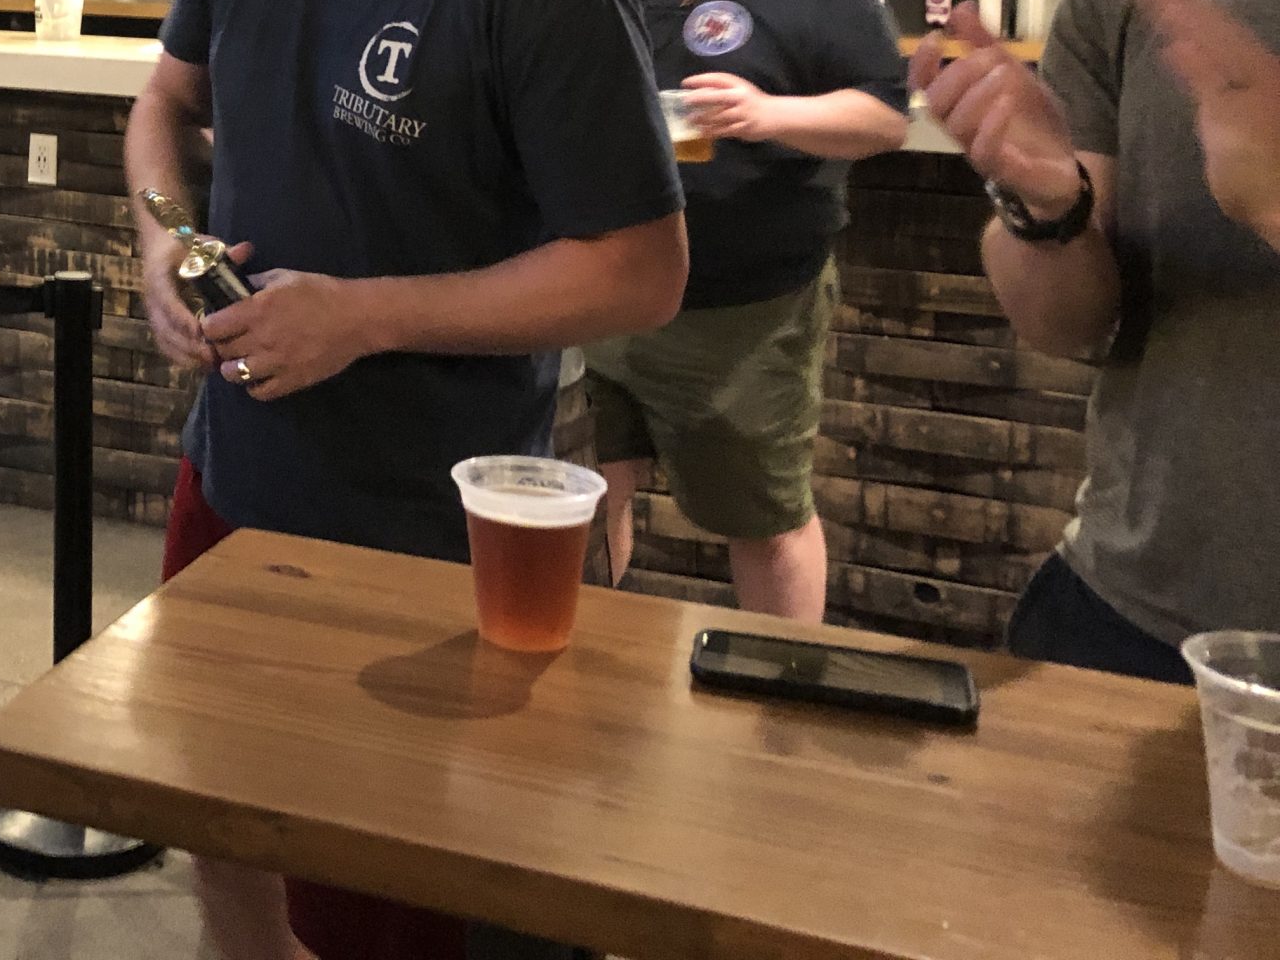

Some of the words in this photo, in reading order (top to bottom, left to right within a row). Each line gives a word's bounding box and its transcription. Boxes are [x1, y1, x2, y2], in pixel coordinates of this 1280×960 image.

[376, 39, 413, 84] T
[332, 84, 428, 138] TRIBUTARY
[333, 105, 387, 143] BREWING
